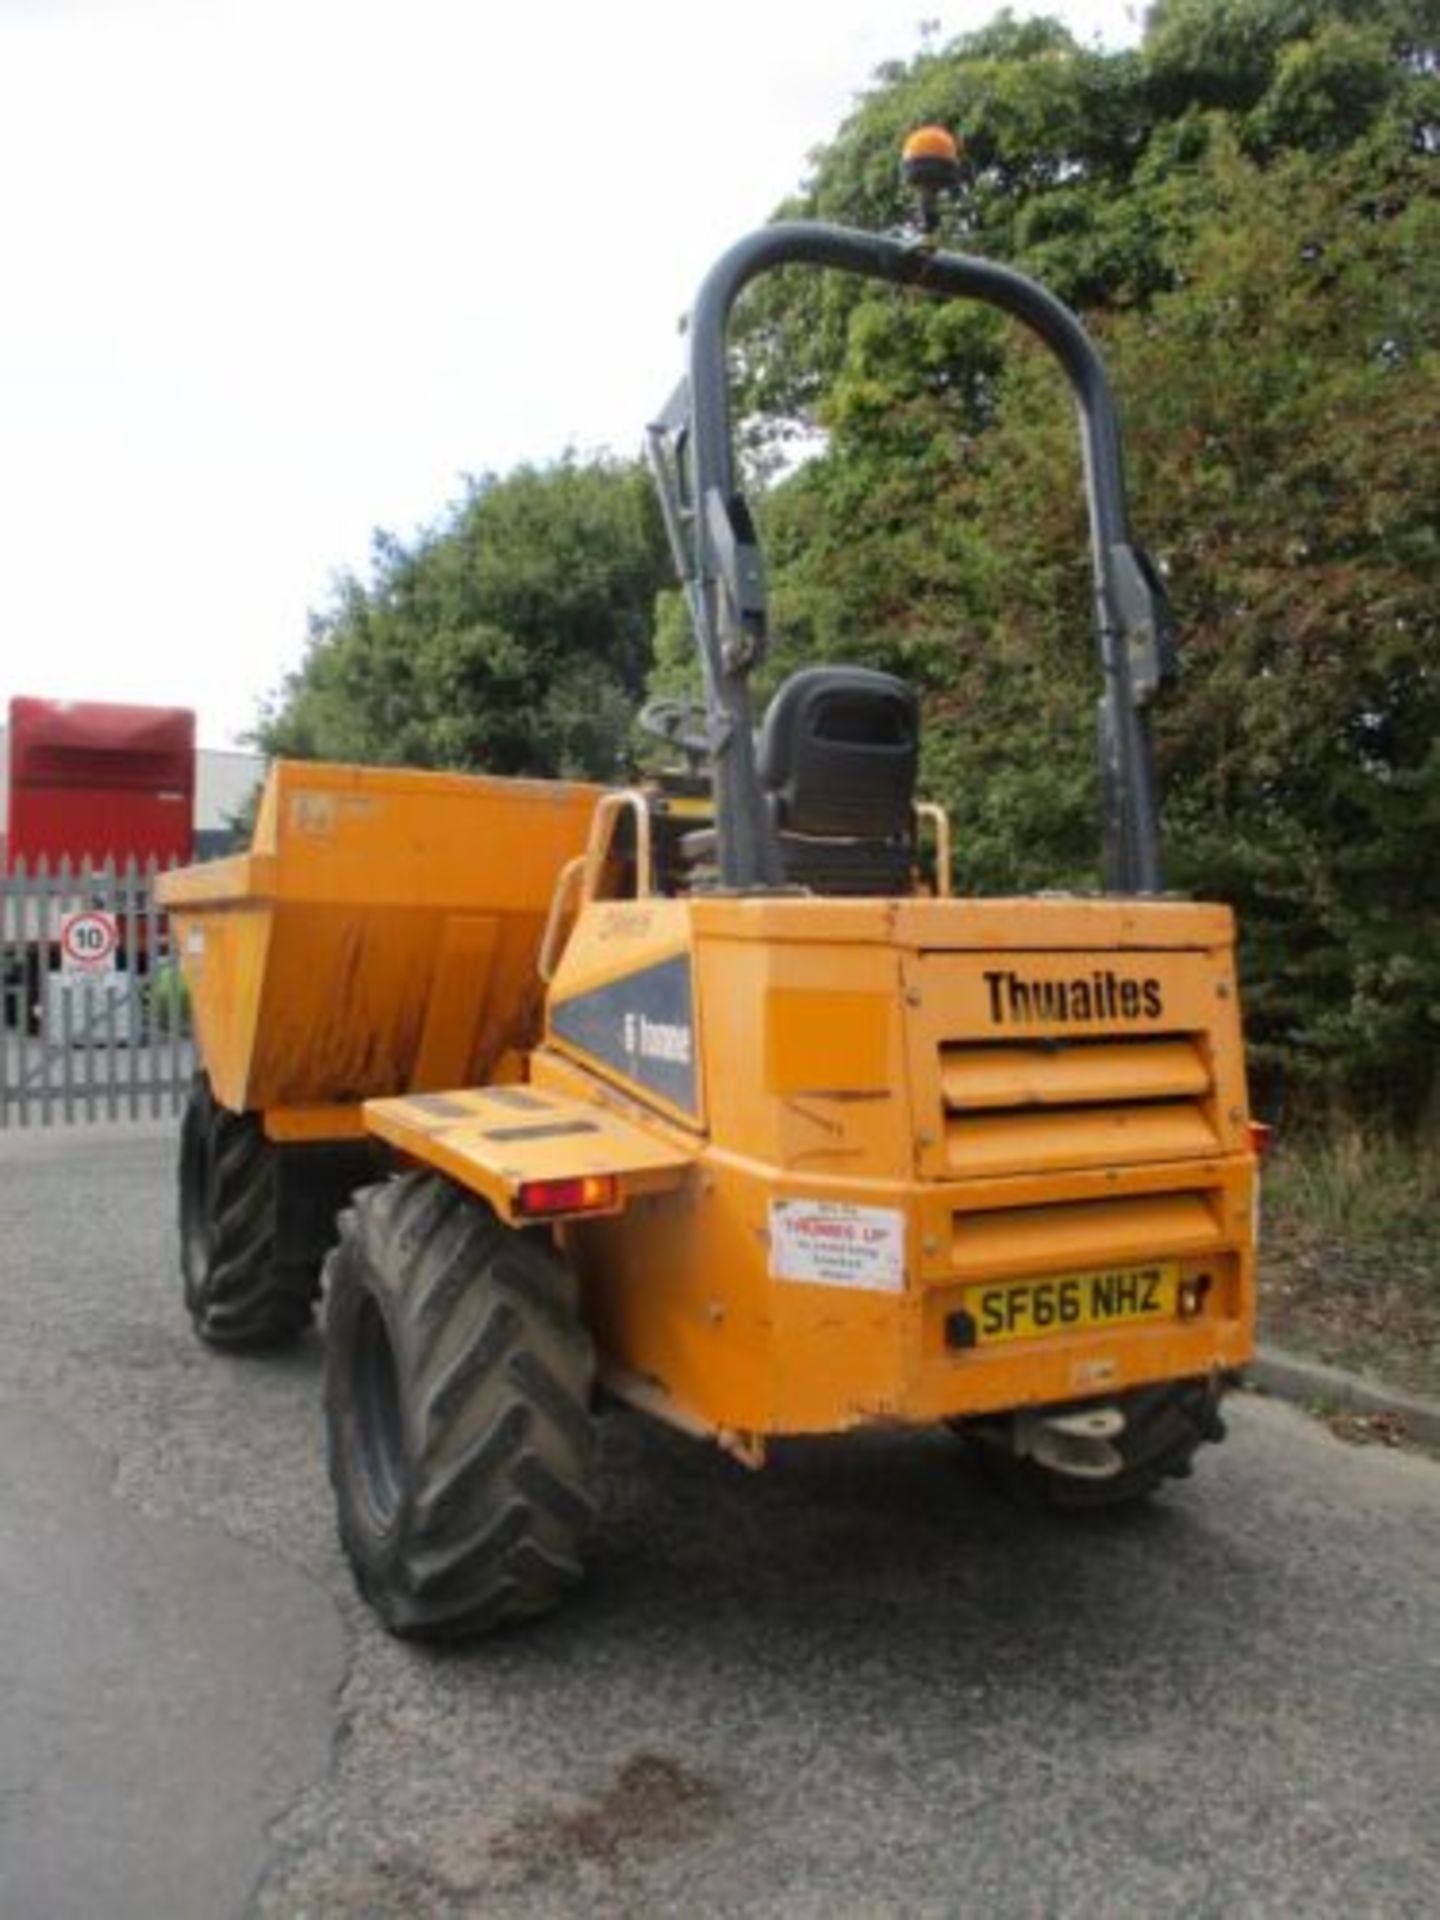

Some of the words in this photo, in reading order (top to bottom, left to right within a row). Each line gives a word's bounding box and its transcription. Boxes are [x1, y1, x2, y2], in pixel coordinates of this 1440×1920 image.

[76, 928, 102, 949] 10
[983, 969, 1163, 1024] Thwaites
[981, 1280, 1081, 1334] SF66
[1090, 1269, 1162, 1320] NHZ
